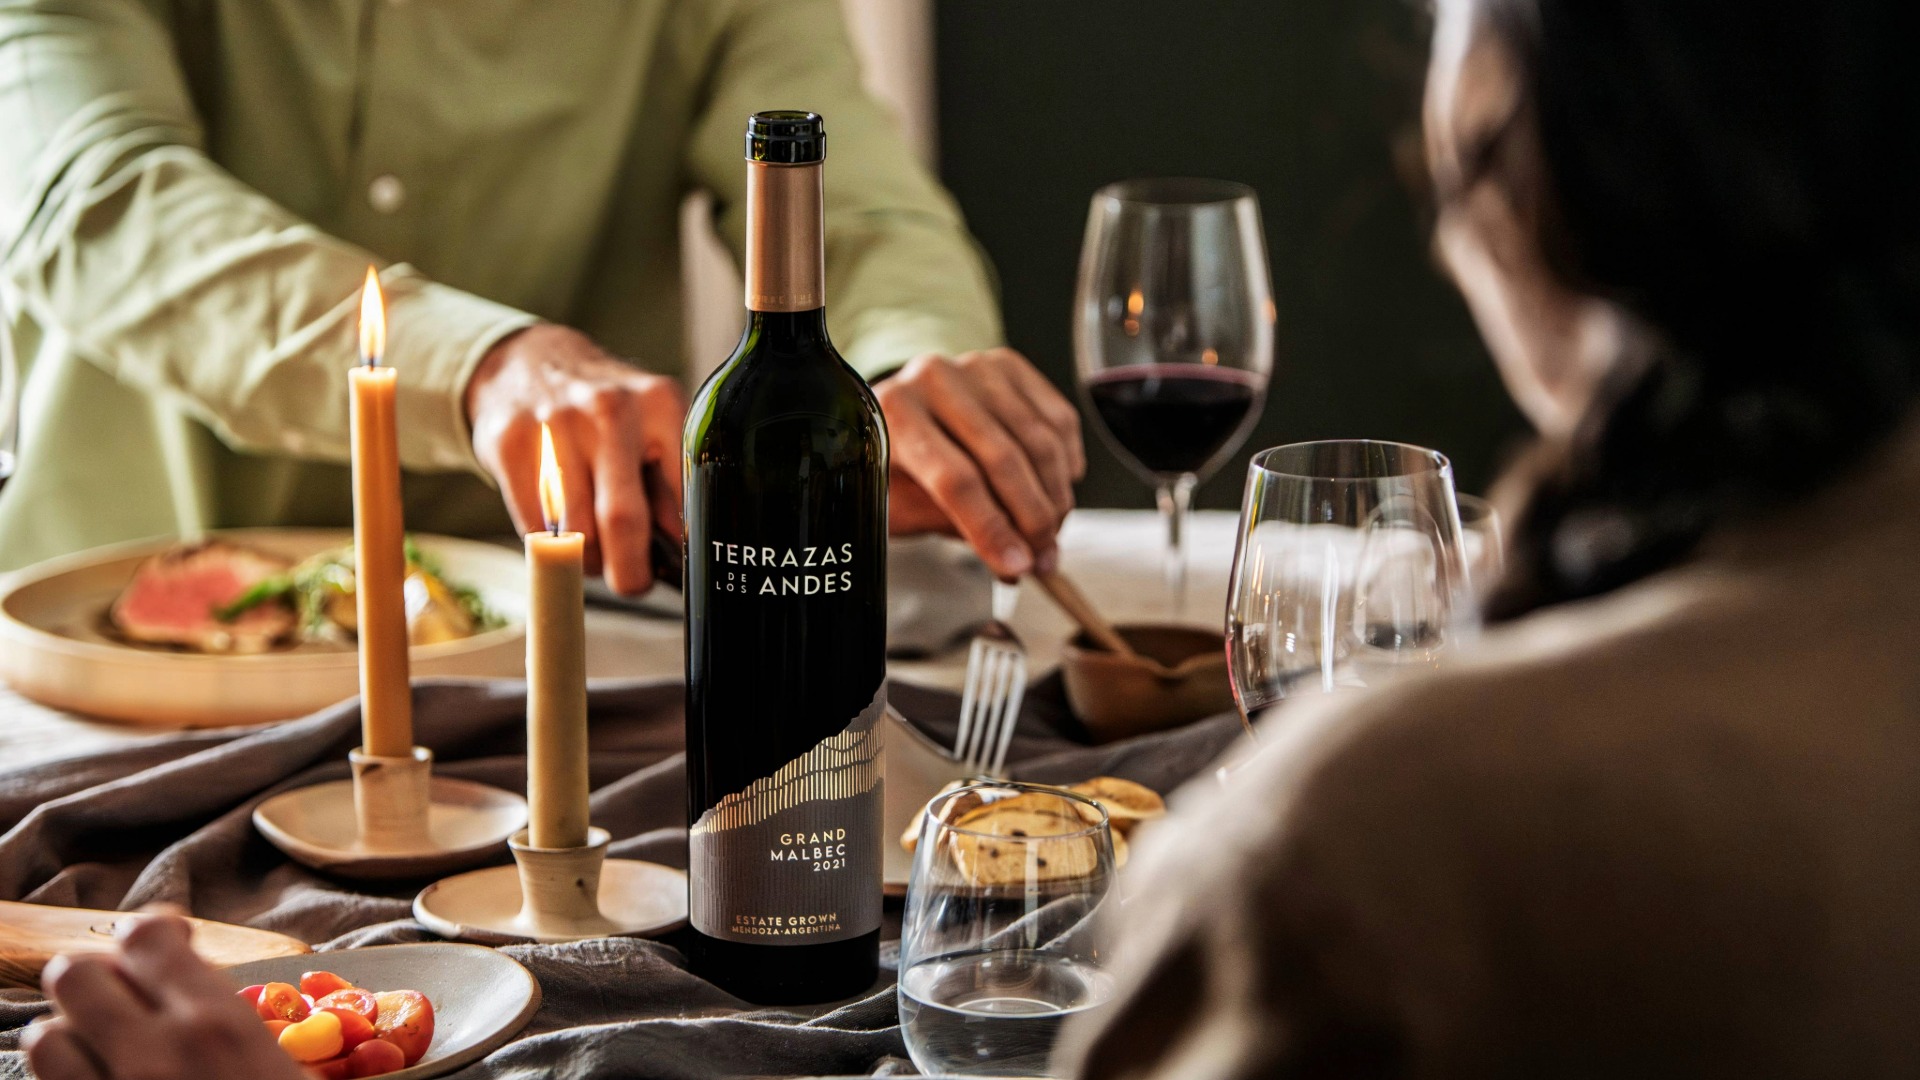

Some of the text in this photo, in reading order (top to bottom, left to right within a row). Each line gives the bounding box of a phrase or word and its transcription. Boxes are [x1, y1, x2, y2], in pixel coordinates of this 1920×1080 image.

[712, 541, 853, 567] TERRAZAS
[728, 572, 747, 583] DE
[758, 571, 852, 596] ANDES
[716, 581, 747, 593] LOS
[780, 828, 846, 845] GRAND
[770, 843, 846, 862] MALBEC
[813, 858, 846, 872] 2021
[736, 912, 837, 926] ESTATE GROWN
